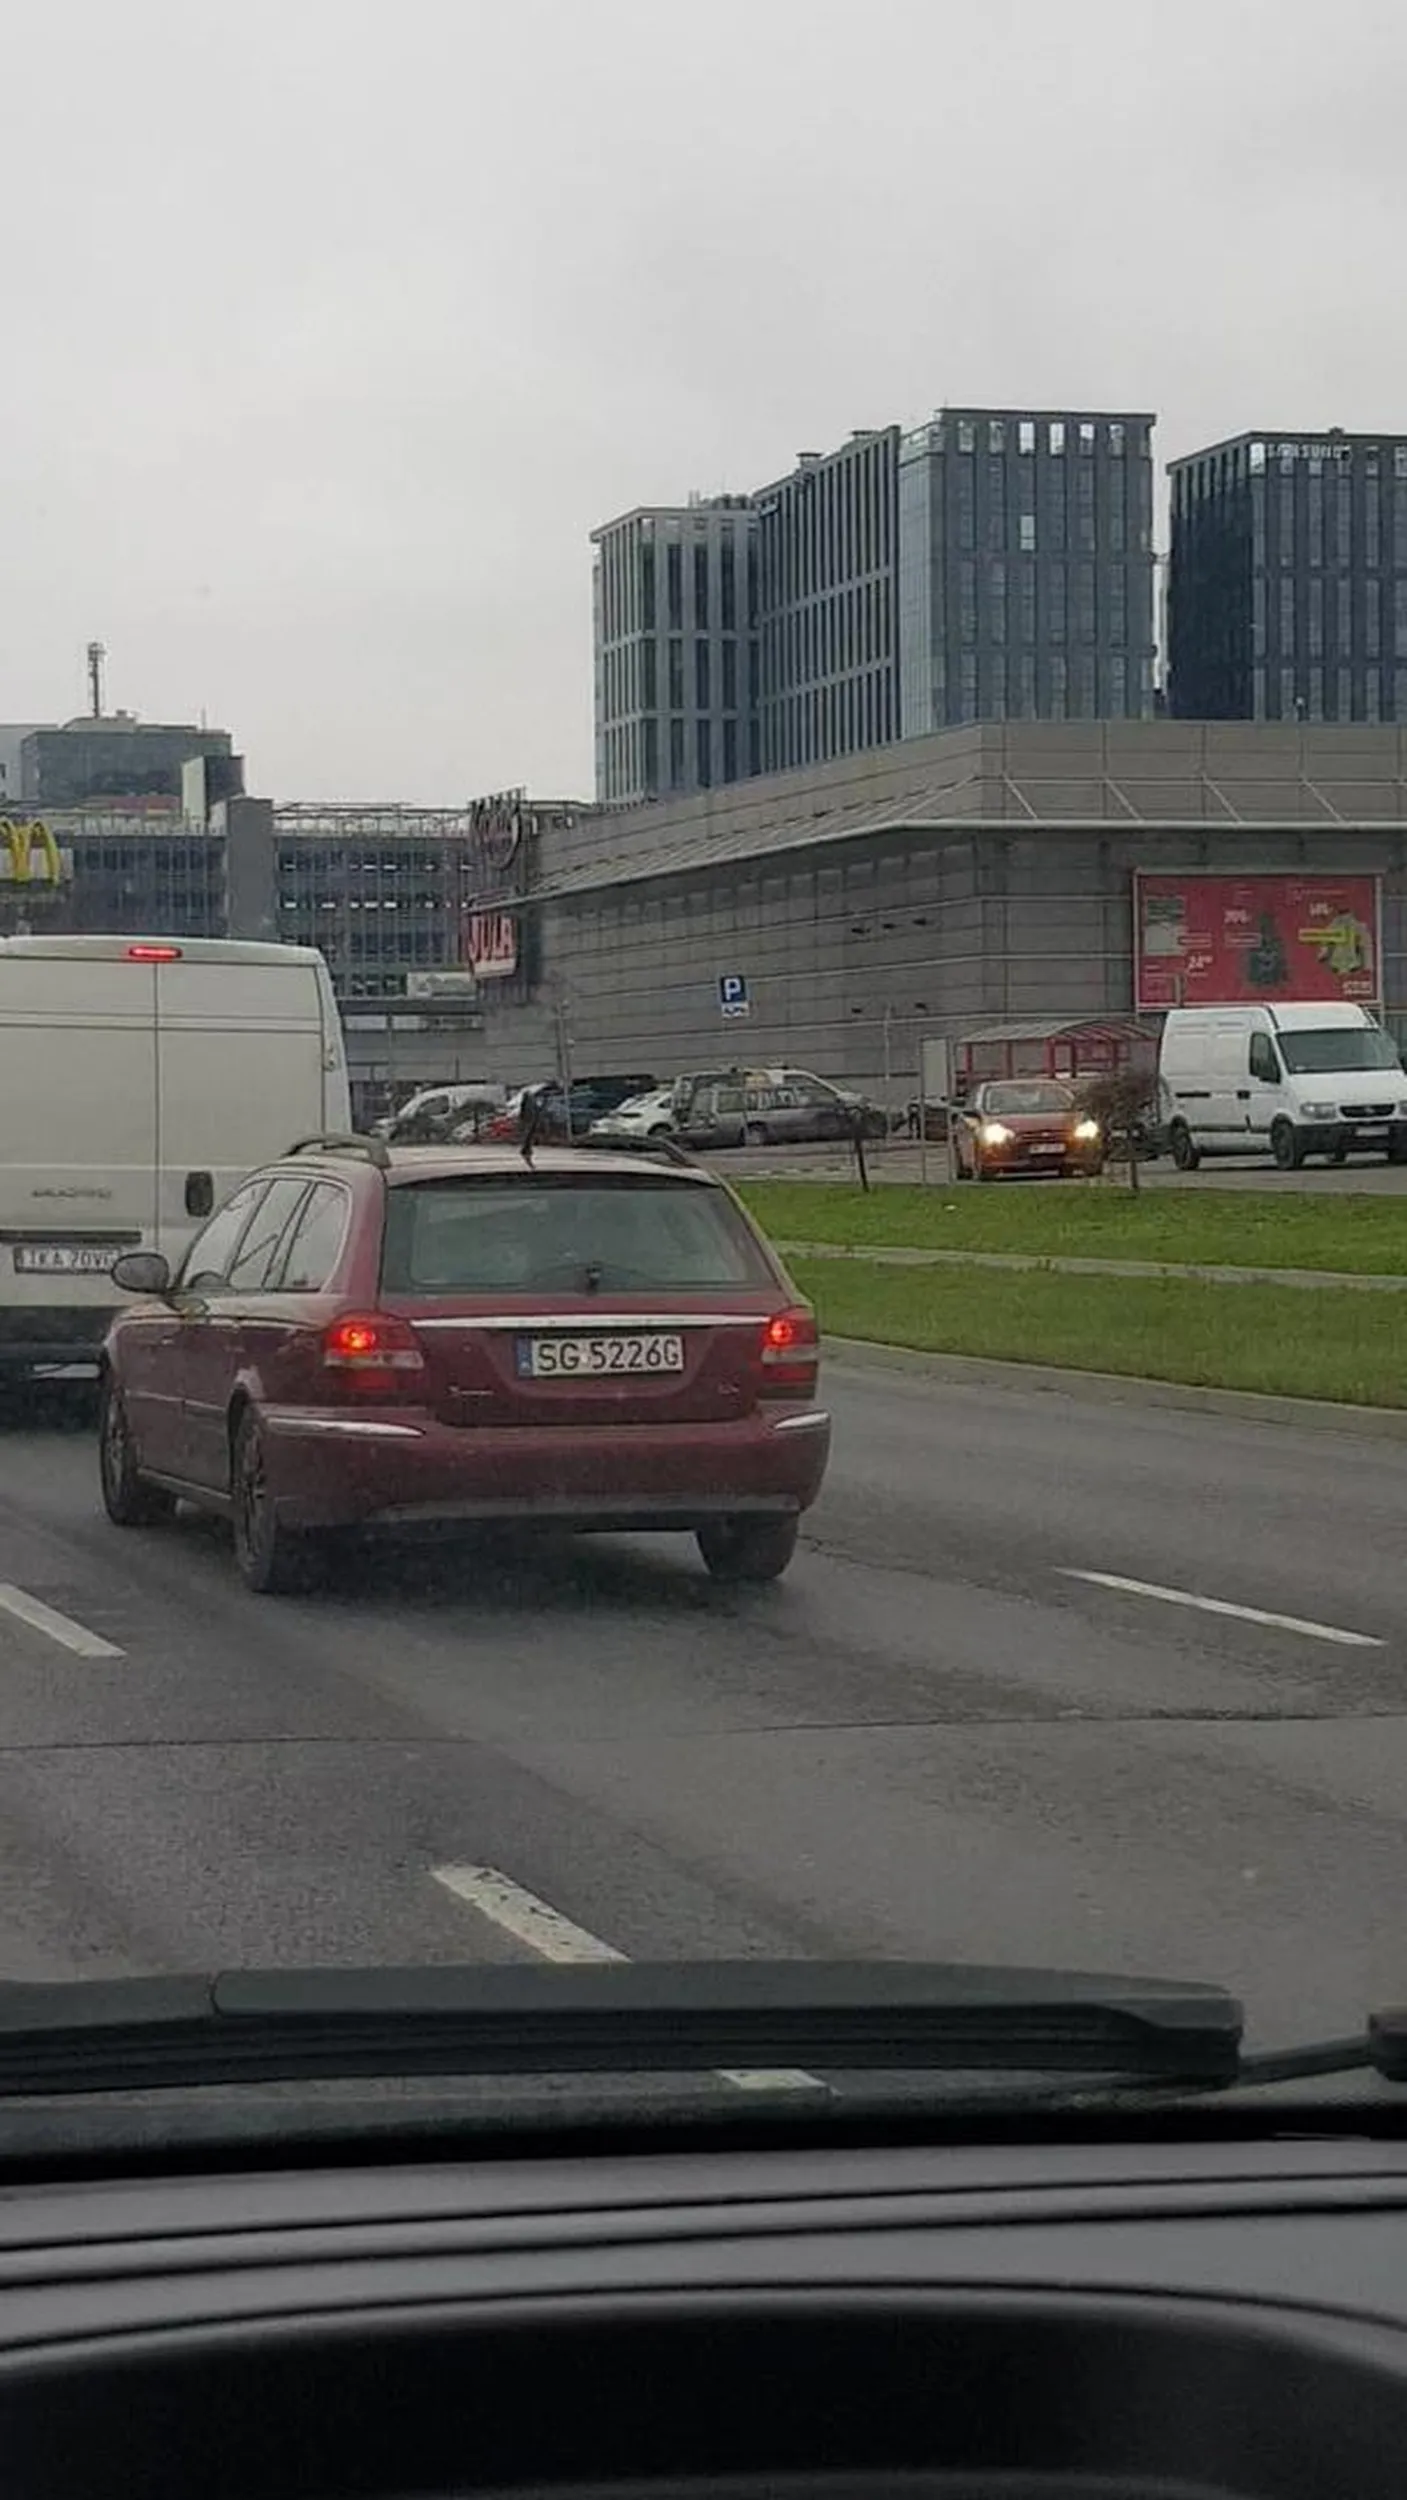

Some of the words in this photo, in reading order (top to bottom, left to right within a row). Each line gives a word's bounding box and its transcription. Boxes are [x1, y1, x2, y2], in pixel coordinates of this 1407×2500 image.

[468, 914, 515, 961] JULA
[724, 978, 741, 1001] P
[538, 1342, 579, 1371] SG
[590, 1338, 679, 1369] 5226G
